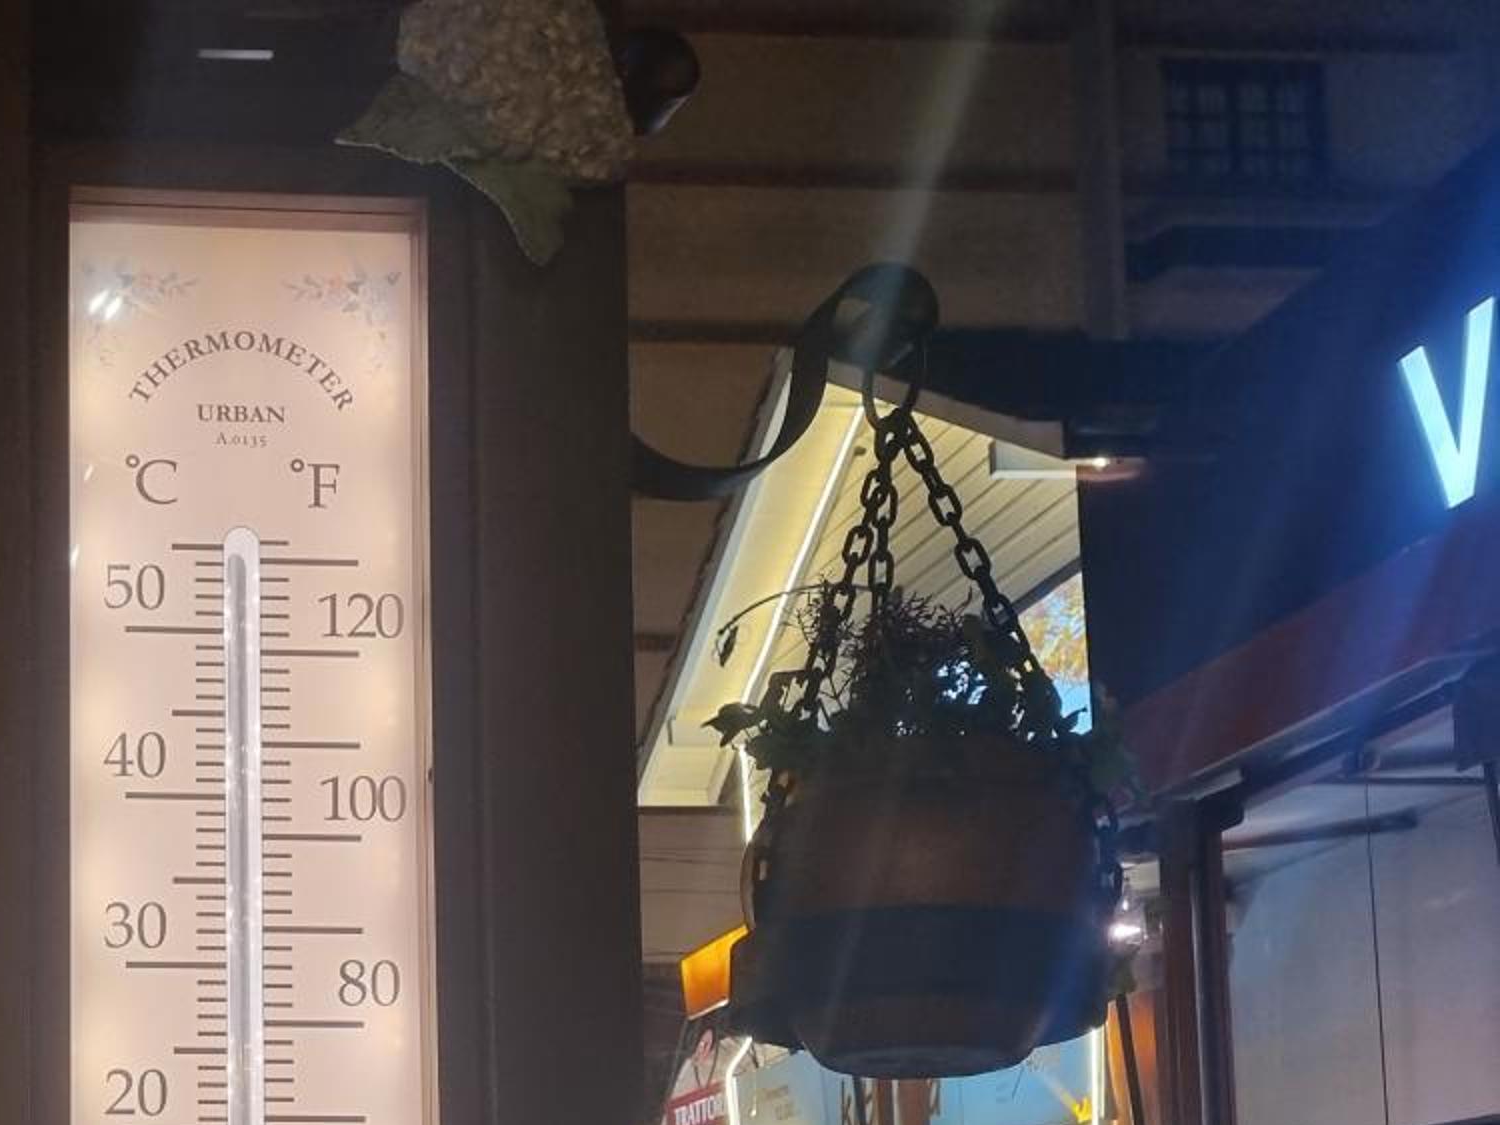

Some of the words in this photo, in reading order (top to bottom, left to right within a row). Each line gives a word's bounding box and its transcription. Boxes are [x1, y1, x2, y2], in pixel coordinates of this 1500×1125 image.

[128, 330, 354, 413] THERMOMETER
[197, 403, 286, 425] URBAN
[103, 564, 166, 611] 50
[317, 592, 405, 639] 120
[103, 731, 167, 779] 40
[320, 775, 407, 822] 100
[104, 901, 167, 949] 30
[337, 959, 400, 1007] 80
[104, 1068, 168, 1117] 20
